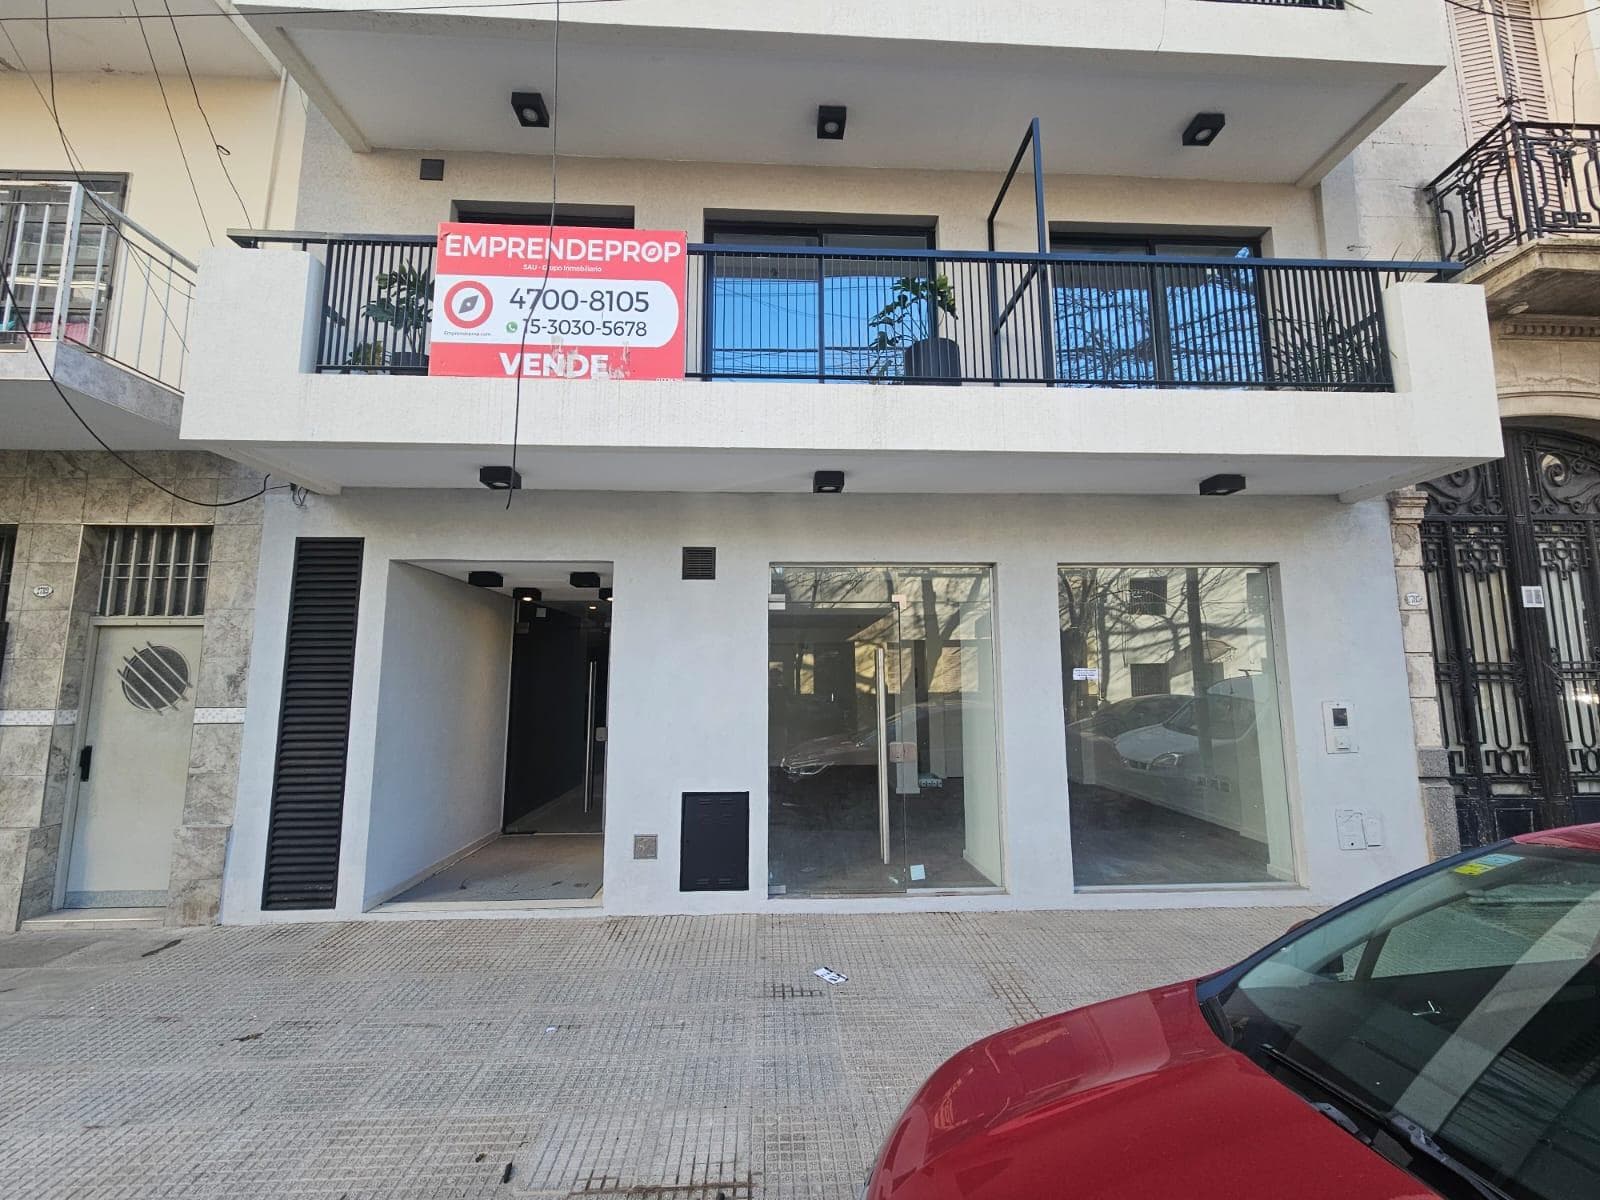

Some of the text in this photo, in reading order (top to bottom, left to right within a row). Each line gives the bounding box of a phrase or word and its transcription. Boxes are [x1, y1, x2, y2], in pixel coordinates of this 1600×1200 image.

[445, 234, 681, 263] EMPRENDEPROP
[523, 263, 537, 271] SAU
[509, 287, 650, 313] 4700-8105
[522, 318, 647, 337] 15-3030-5678
[499, 352, 609, 378] VENDE
